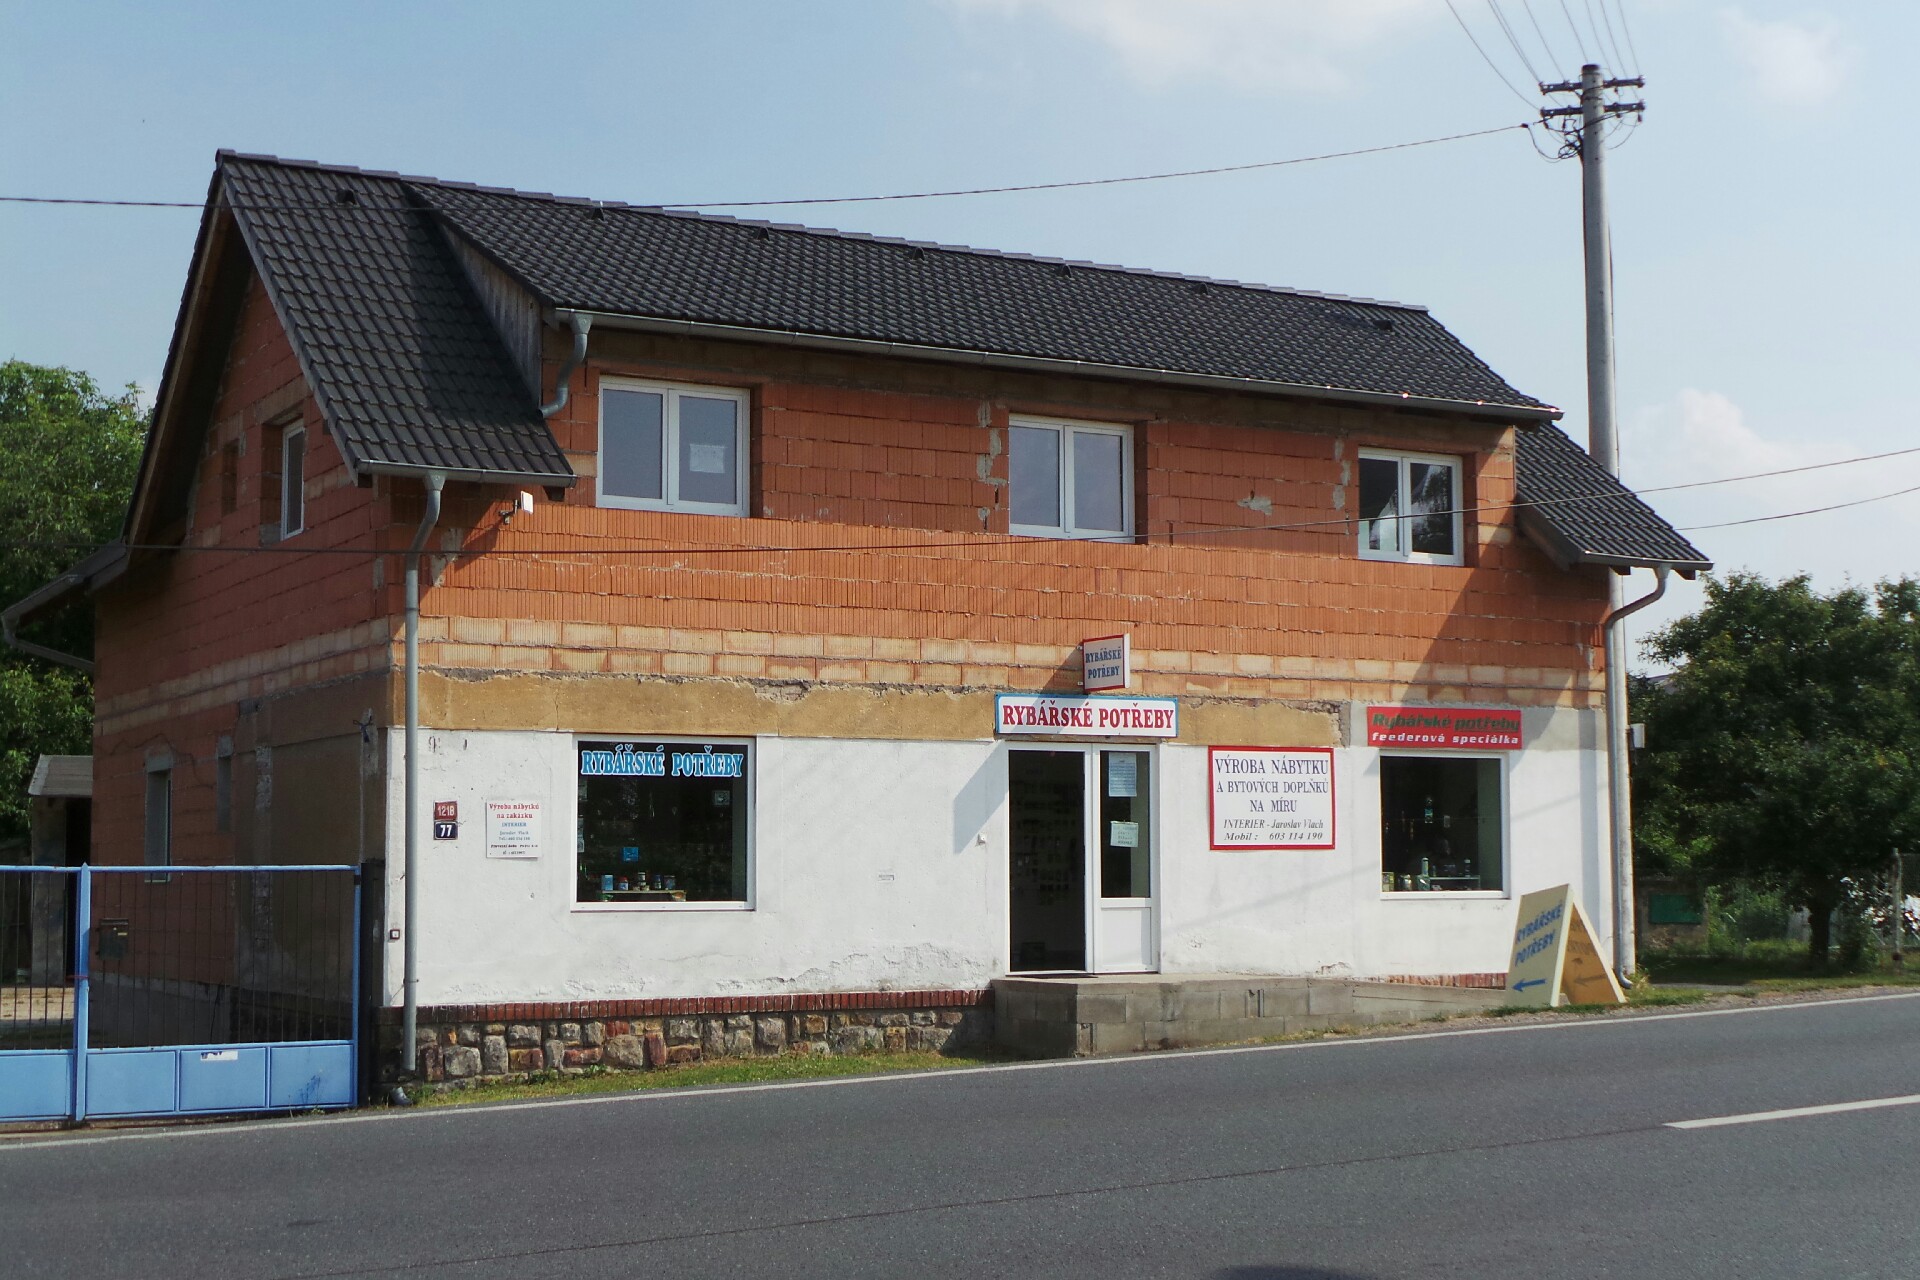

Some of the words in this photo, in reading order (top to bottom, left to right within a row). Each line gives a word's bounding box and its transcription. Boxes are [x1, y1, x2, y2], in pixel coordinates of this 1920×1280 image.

[1085, 646, 1122, 663] RYBÁŘSKÉ
[1088, 664, 1120, 679] POTŘEBY
[1002, 699, 1093, 728] RYBÁŘSKÉ
[1099, 702, 1174, 729] POTŘEBY
[1372, 713, 1450, 729] Rybářské
[1454, 716, 1520, 732] potřeby
[1372, 732, 1445, 743] feederová
[1452, 734, 1519, 745] speciálka
[581, 744, 665, 776] RYBÁŘSKÉ
[671, 745, 744, 777] POTŘEBY
[1215, 754, 1265, 774] VÝROBA
[1271, 755, 1329, 775] NÁBYTKU
[1216, 781, 1223, 793] A
[1228, 778, 1278, 793] BYTOVÝCH
[1283, 778, 1329, 793] DOPLŇKŮ
[489, 803, 511, 811] Výroba
[1250, 800, 1264, 812] NA
[1271, 797, 1297, 812] MÍRU
[440, 824, 452, 837] 77
[1223, 819, 1265, 829] INTERIER
[1271, 819, 1301, 829] Jaroslav
[1303, 819, 1324, 829] Vlach
[1224, 832, 1252, 841] Mobil
[1269, 832, 1285, 841] 603
[1288, 832, 1304, 840] 114
[1307, 832, 1323, 840] 190
[1515, 900, 1562, 943] RYBÁŘSKÉ
[1515, 930, 1555, 967] POTŘEBY
